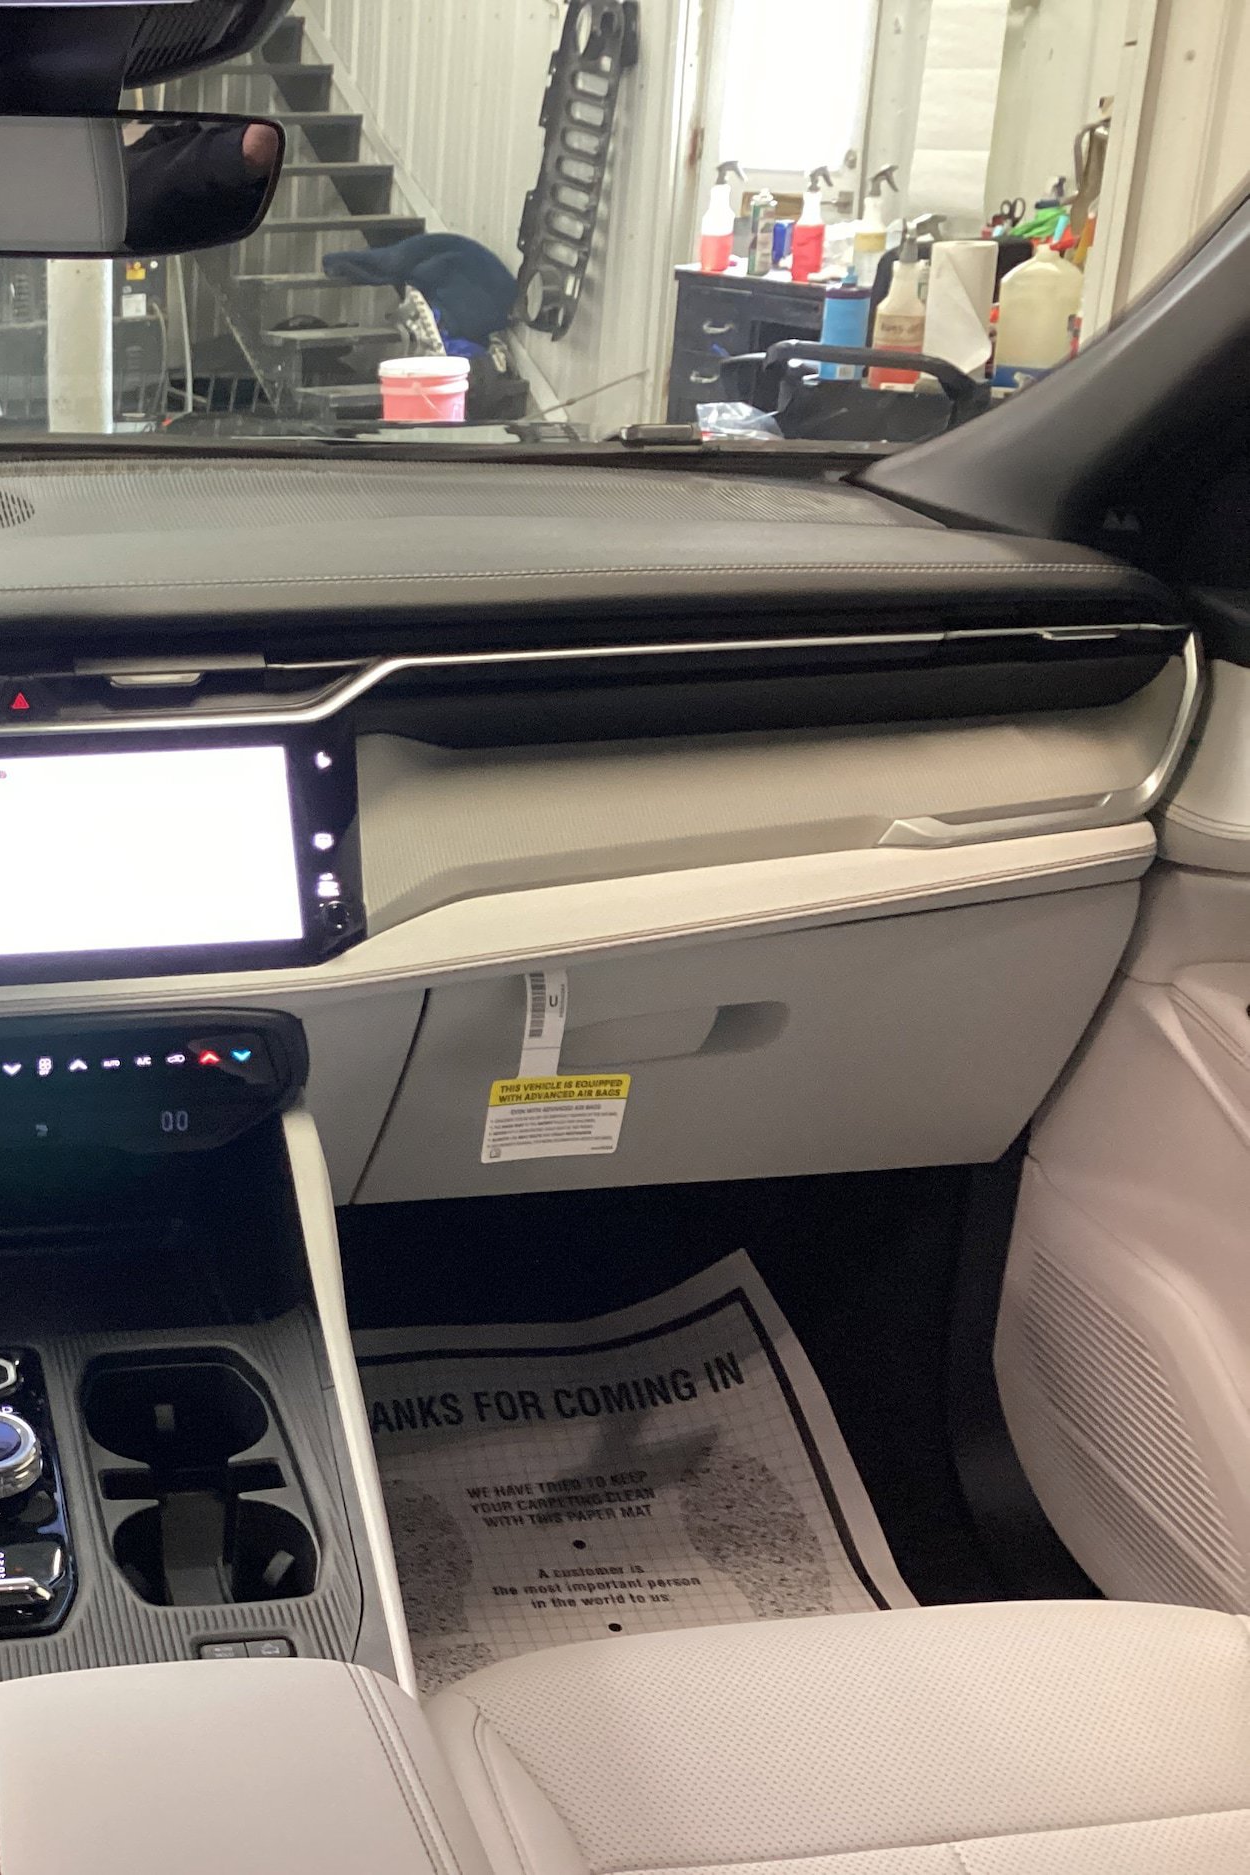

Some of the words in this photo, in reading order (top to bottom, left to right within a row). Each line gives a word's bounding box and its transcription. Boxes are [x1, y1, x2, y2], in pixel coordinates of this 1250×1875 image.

[136, 1056, 151, 1065] A/C
[499, 1093, 522, 1103] WITH
[524, 1090, 575, 1102] ADVANCED
[577, 1089, 593, 1098] AIR
[595, 1088, 621, 1097] BAGS
[501, 1084, 521, 1094] THIS
[523, 1081, 562, 1092] VEHICLE
[564, 1081, 573, 1090] IS
[575, 1079, 623, 1089] EQUIPPED
[371, 1392, 464, 1434] ANKS
[472, 1389, 546, 1423] FOR
[553, 1368, 698, 1419] COMING
[703, 1352, 745, 1393] IN
[466, 1487, 490, 1499] WE
[493, 1483, 535, 1498] HAVE
[535, 1479, 582, 1494] TRIED
[587, 1475, 607, 1489] TO
[610, 1470, 648, 1487] KEEP
[471, 1500, 514, 1515] YOUR
[517, 1493, 603, 1511] CARPETING
[606, 1487, 656, 1504] CLEAN
[482, 1514, 525, 1528] WITH
[528, 1511, 563, 1525] THIS
[566, 1507, 617, 1522] PAPER
[620, 1504, 654, 1518] MAT
[538, 1568, 549, 1579] A
[553, 1566, 624, 1578] customer
[629, 1564, 645, 1574] is
[492, 1585, 518, 1596] the
[523, 1583, 563, 1595] most
[566, 1578, 644, 1594] important
[647, 1576, 701, 1590] person
[531, 1599, 547, 1609] in
[551, 1596, 577, 1608] the
[580, 1593, 626, 1606] world
[630, 1593, 646, 1604] to
